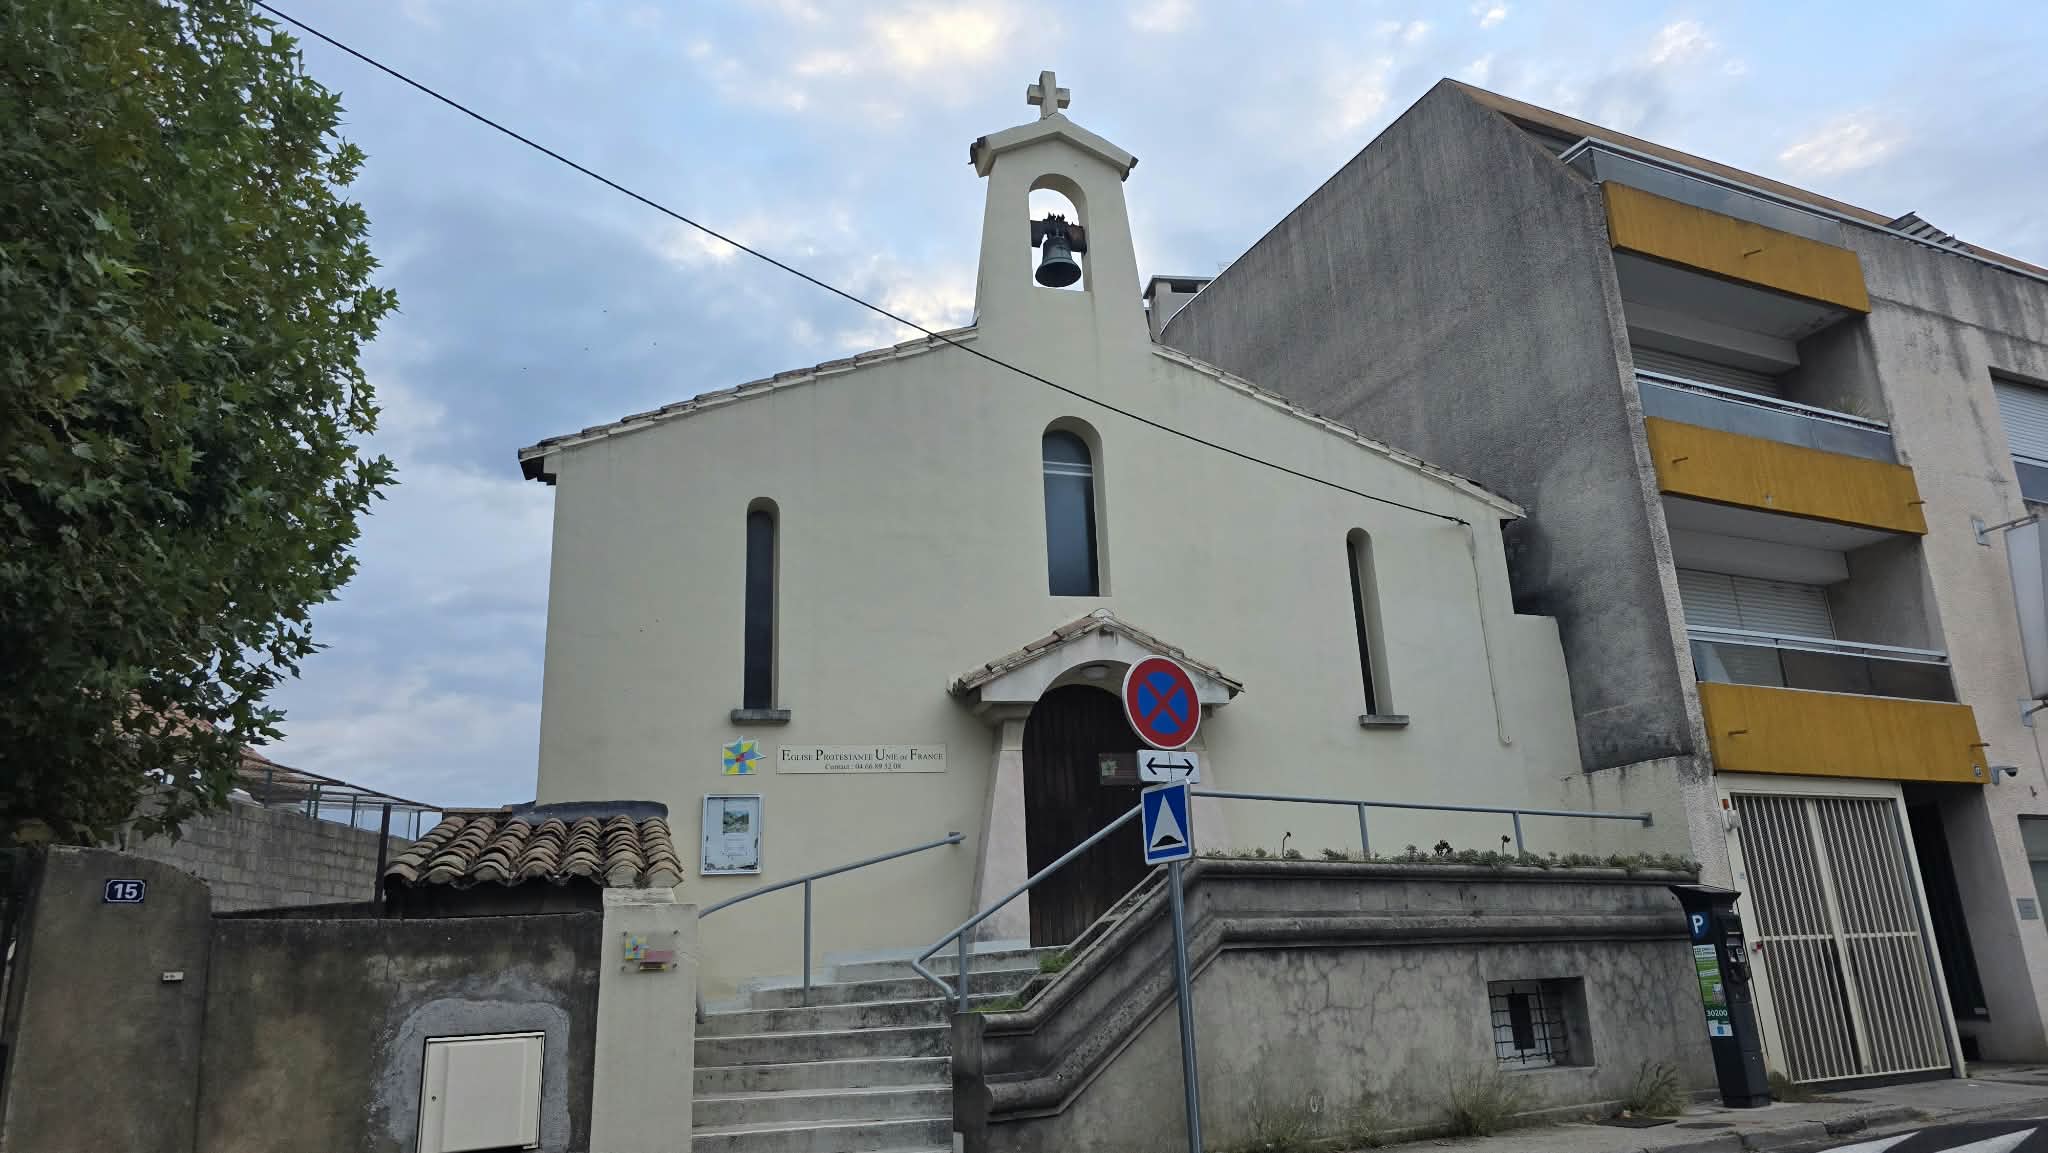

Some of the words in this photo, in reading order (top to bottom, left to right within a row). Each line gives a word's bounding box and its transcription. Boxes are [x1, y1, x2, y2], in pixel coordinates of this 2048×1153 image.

[114, 883, 138, 899] 15
[1692, 914, 1704, 934] P
[1706, 1009, 1728, 1017] 30200
